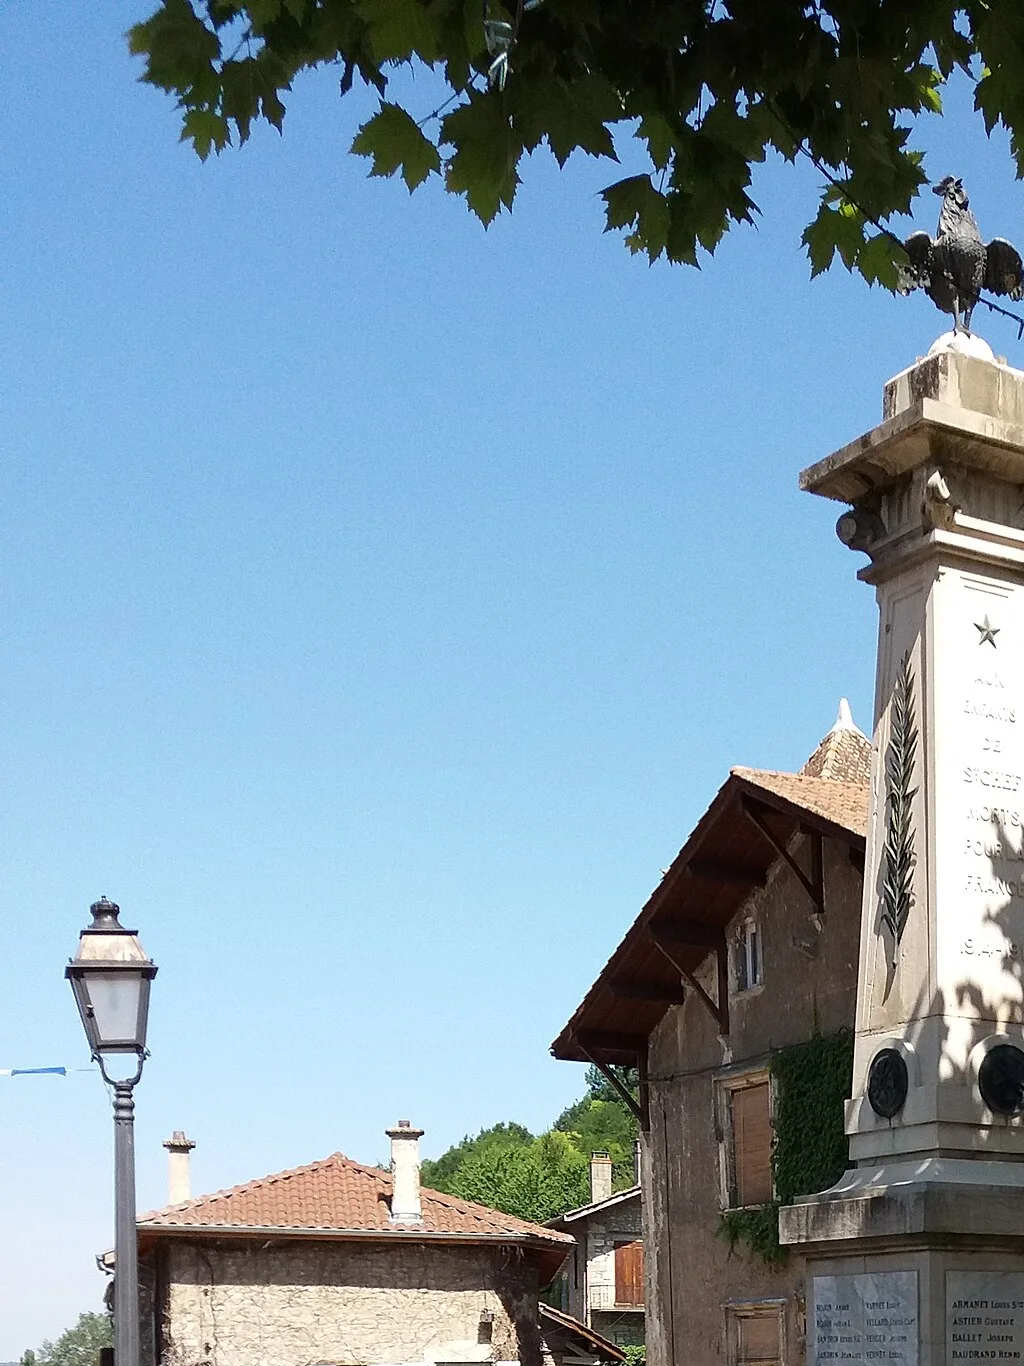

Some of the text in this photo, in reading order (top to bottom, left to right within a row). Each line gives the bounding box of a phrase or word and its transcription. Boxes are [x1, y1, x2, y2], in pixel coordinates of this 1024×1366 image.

[982, 736, 1001, 753] DE
[964, 806, 1021, 828] MORTS
[952, 1317, 982, 1326] ASTIER
[952, 1334, 982, 1342] BALLET
